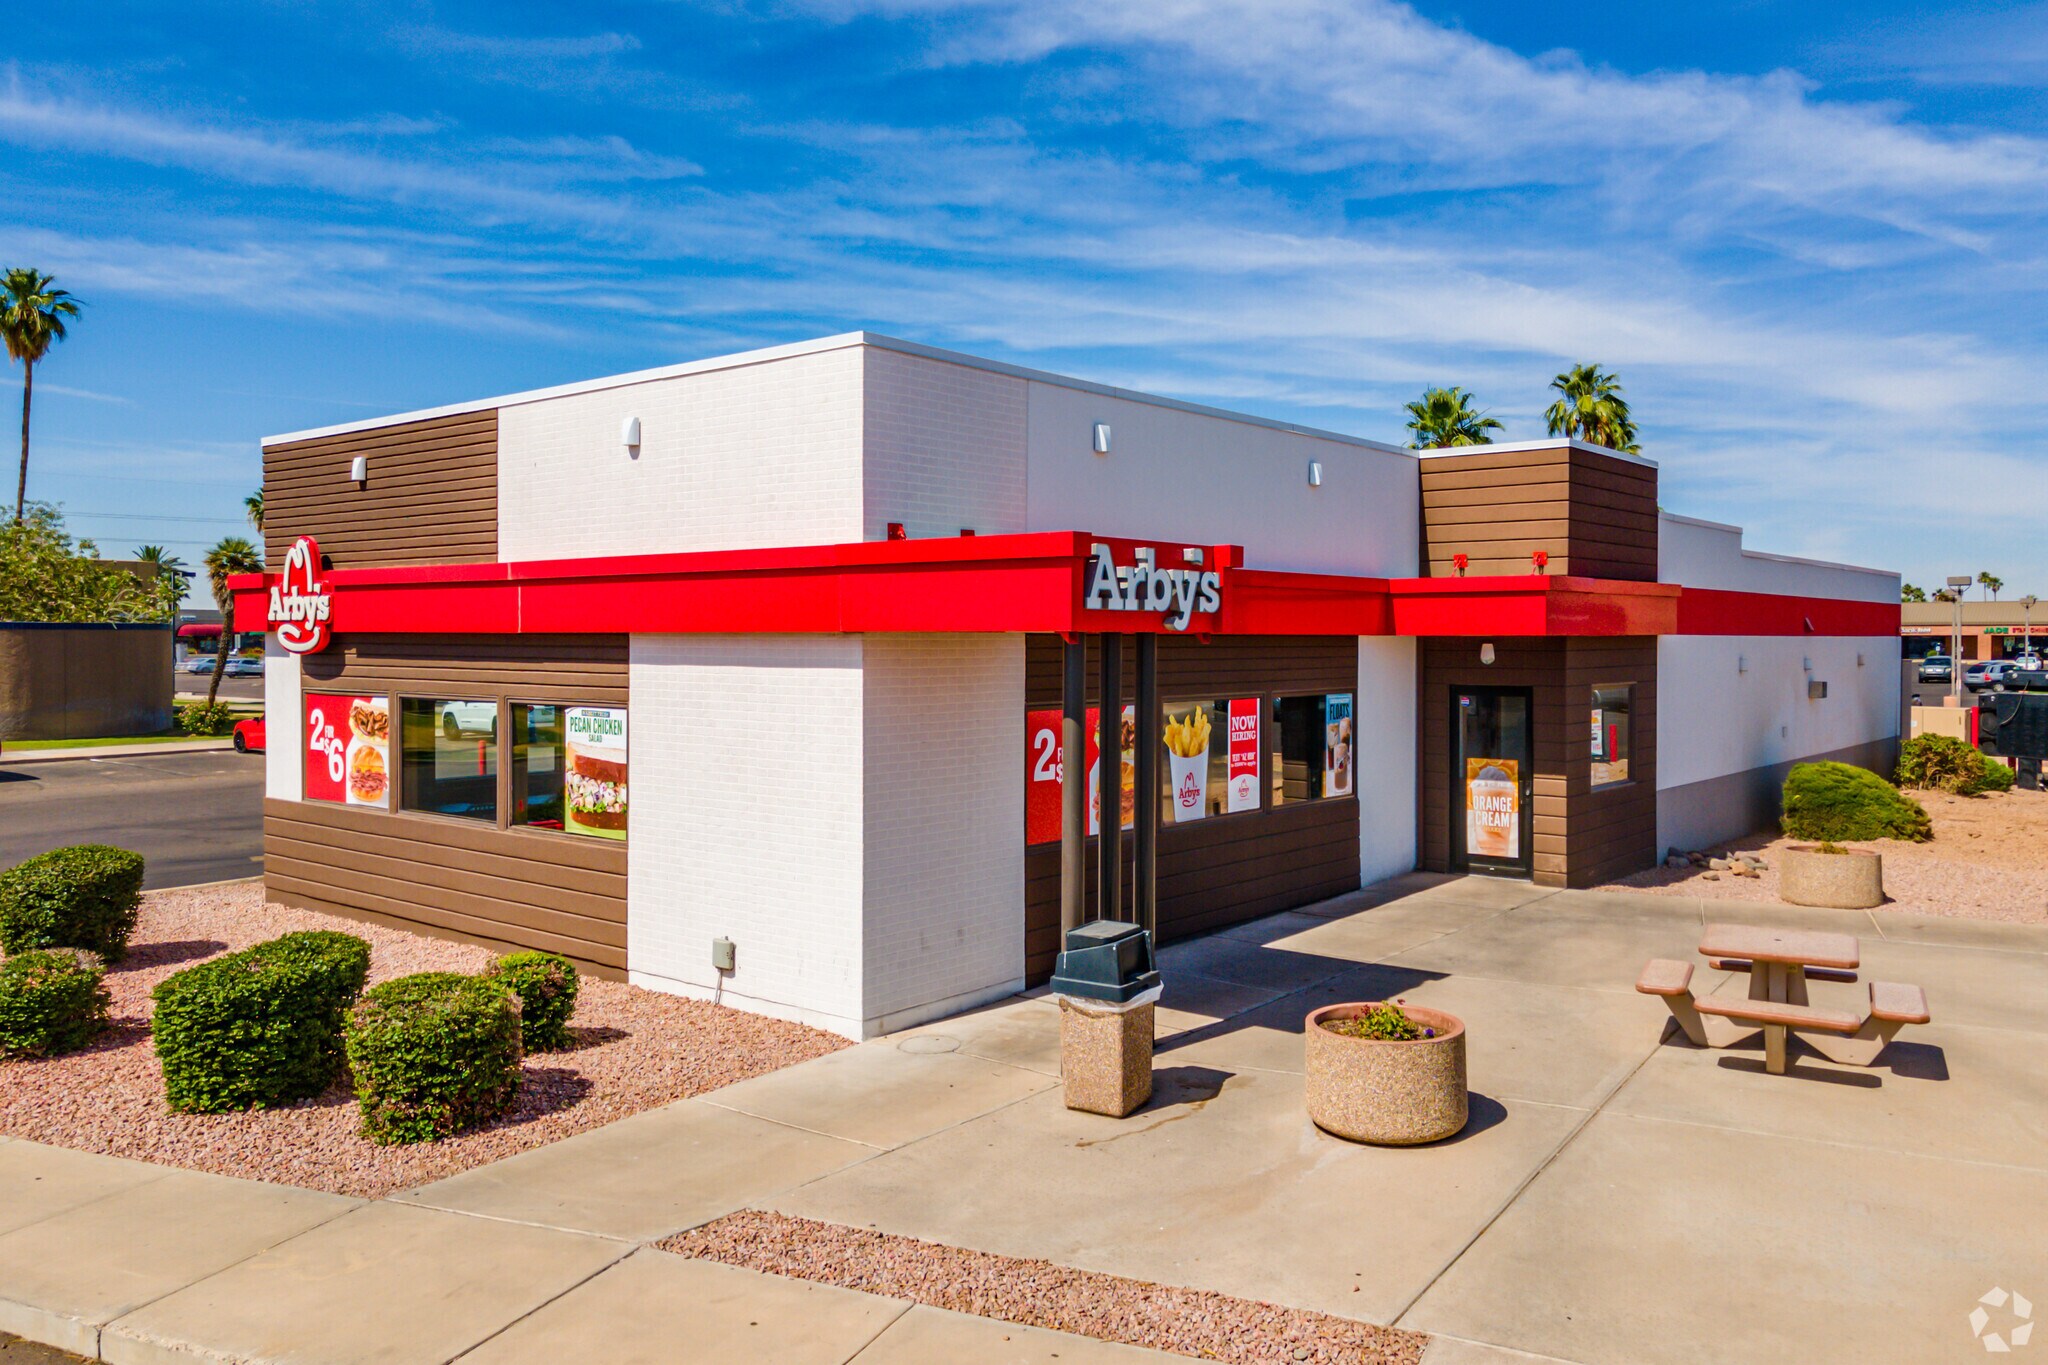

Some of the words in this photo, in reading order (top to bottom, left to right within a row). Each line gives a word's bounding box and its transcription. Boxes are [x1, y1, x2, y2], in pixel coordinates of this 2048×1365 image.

[1084, 543, 1221, 632] Arby's
[267, 583, 330, 631] Arby's
[1984, 626, 2009, 635] JADE
[310, 708, 325, 751] 2
[570, 716, 591, 733] PECAN
[593, 718, 622, 735] CHICKEN
[1231, 715, 1257, 731] NOW
[588, 734, 602, 742] SALAD
[1231, 730, 1257, 742] HIRING
[1033, 728, 1056, 782] 2
[1179, 785, 1201, 800] Arby's
[1473, 795, 1513, 813] ORANGE
[1475, 811, 1510, 828] CREAM
